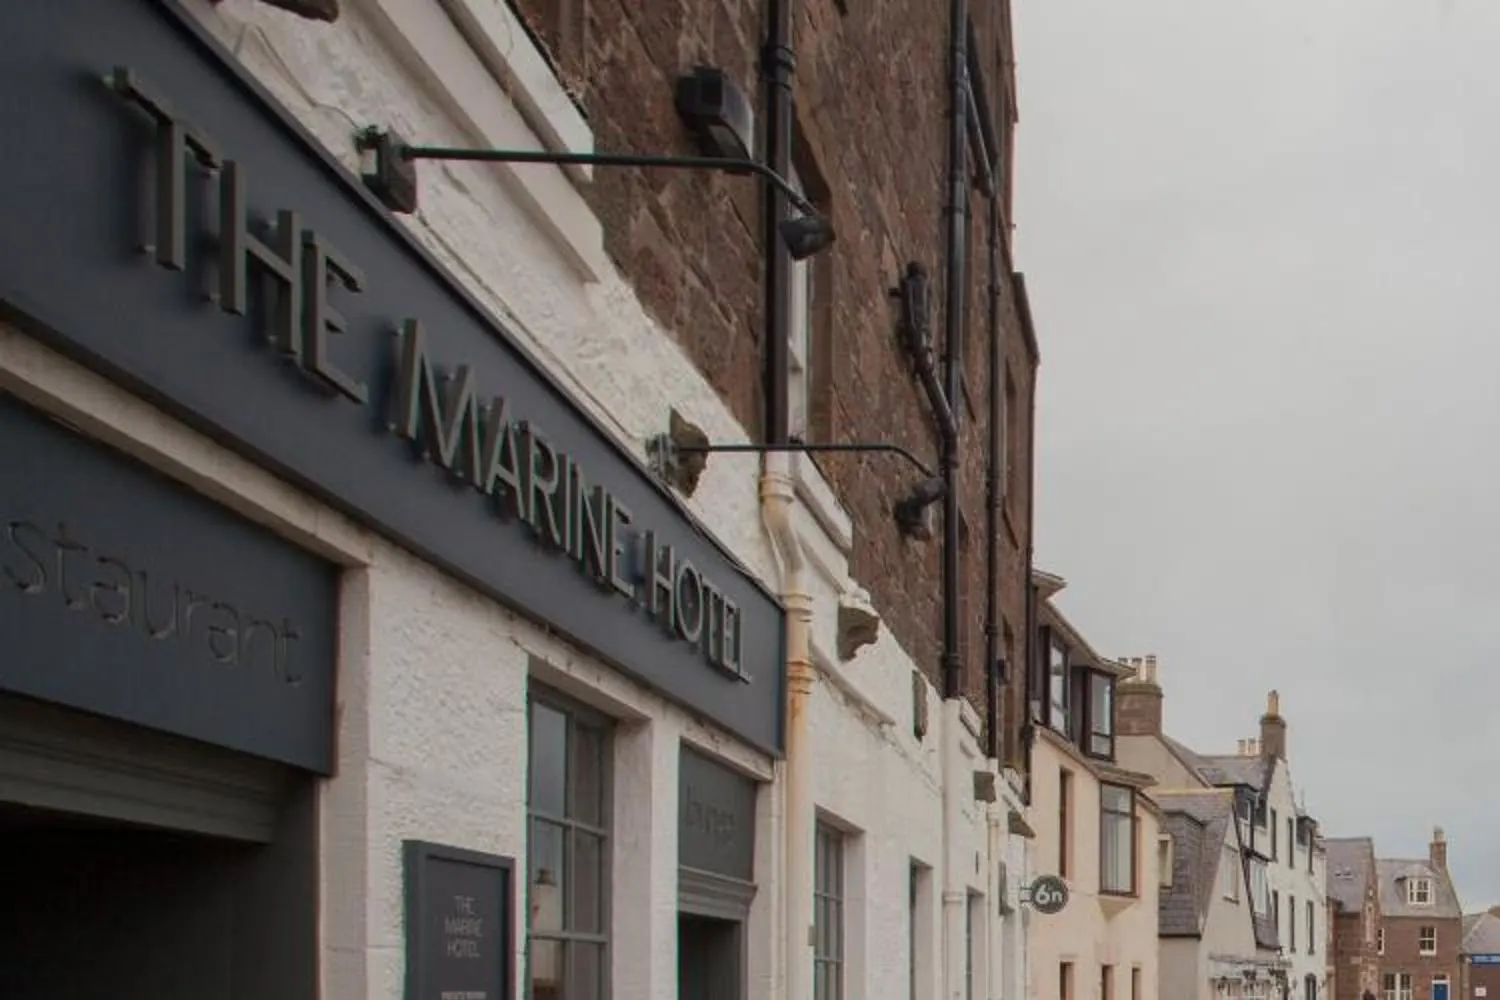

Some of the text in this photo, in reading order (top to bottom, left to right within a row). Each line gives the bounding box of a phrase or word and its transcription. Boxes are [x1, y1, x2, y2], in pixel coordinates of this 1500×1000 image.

[105, 66, 752, 685] THE MARINE HOTEL
